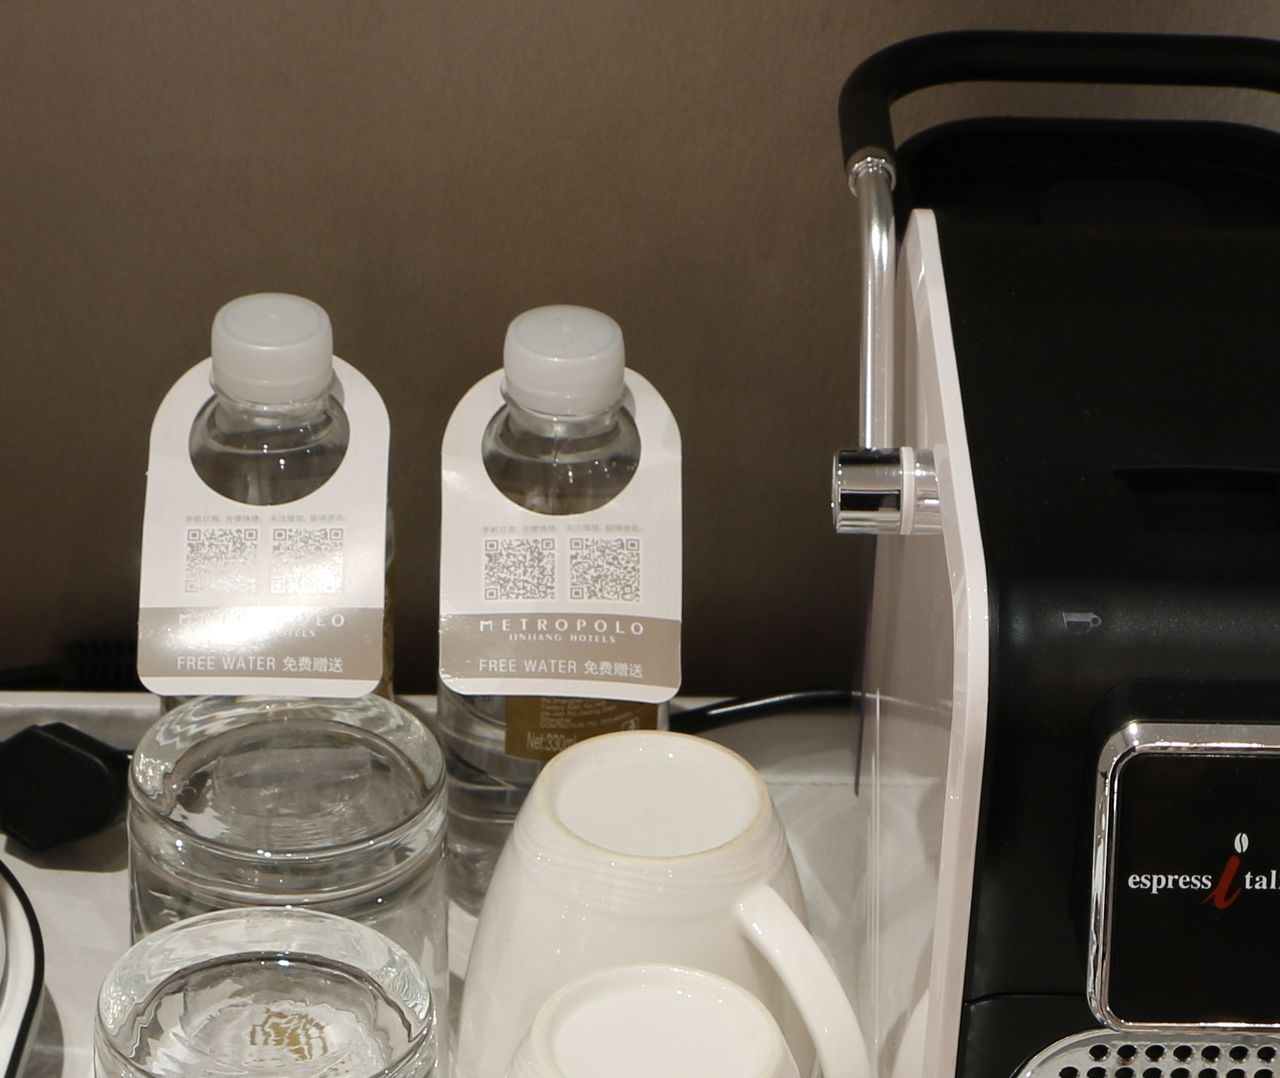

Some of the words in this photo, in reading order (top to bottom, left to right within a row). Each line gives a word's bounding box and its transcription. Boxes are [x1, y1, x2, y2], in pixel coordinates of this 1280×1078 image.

[480, 618, 644, 635] METROPOLO
[570, 634, 616, 644] HOTELS
[177, 656, 216, 670] FREE
[222, 656, 276, 670] WATER
[282, 656, 344, 673] 免费赠送
[479, 658, 516, 672] FREE
[524, 660, 577, 674] WATER
[584, 660, 643, 678] 免费赠送
